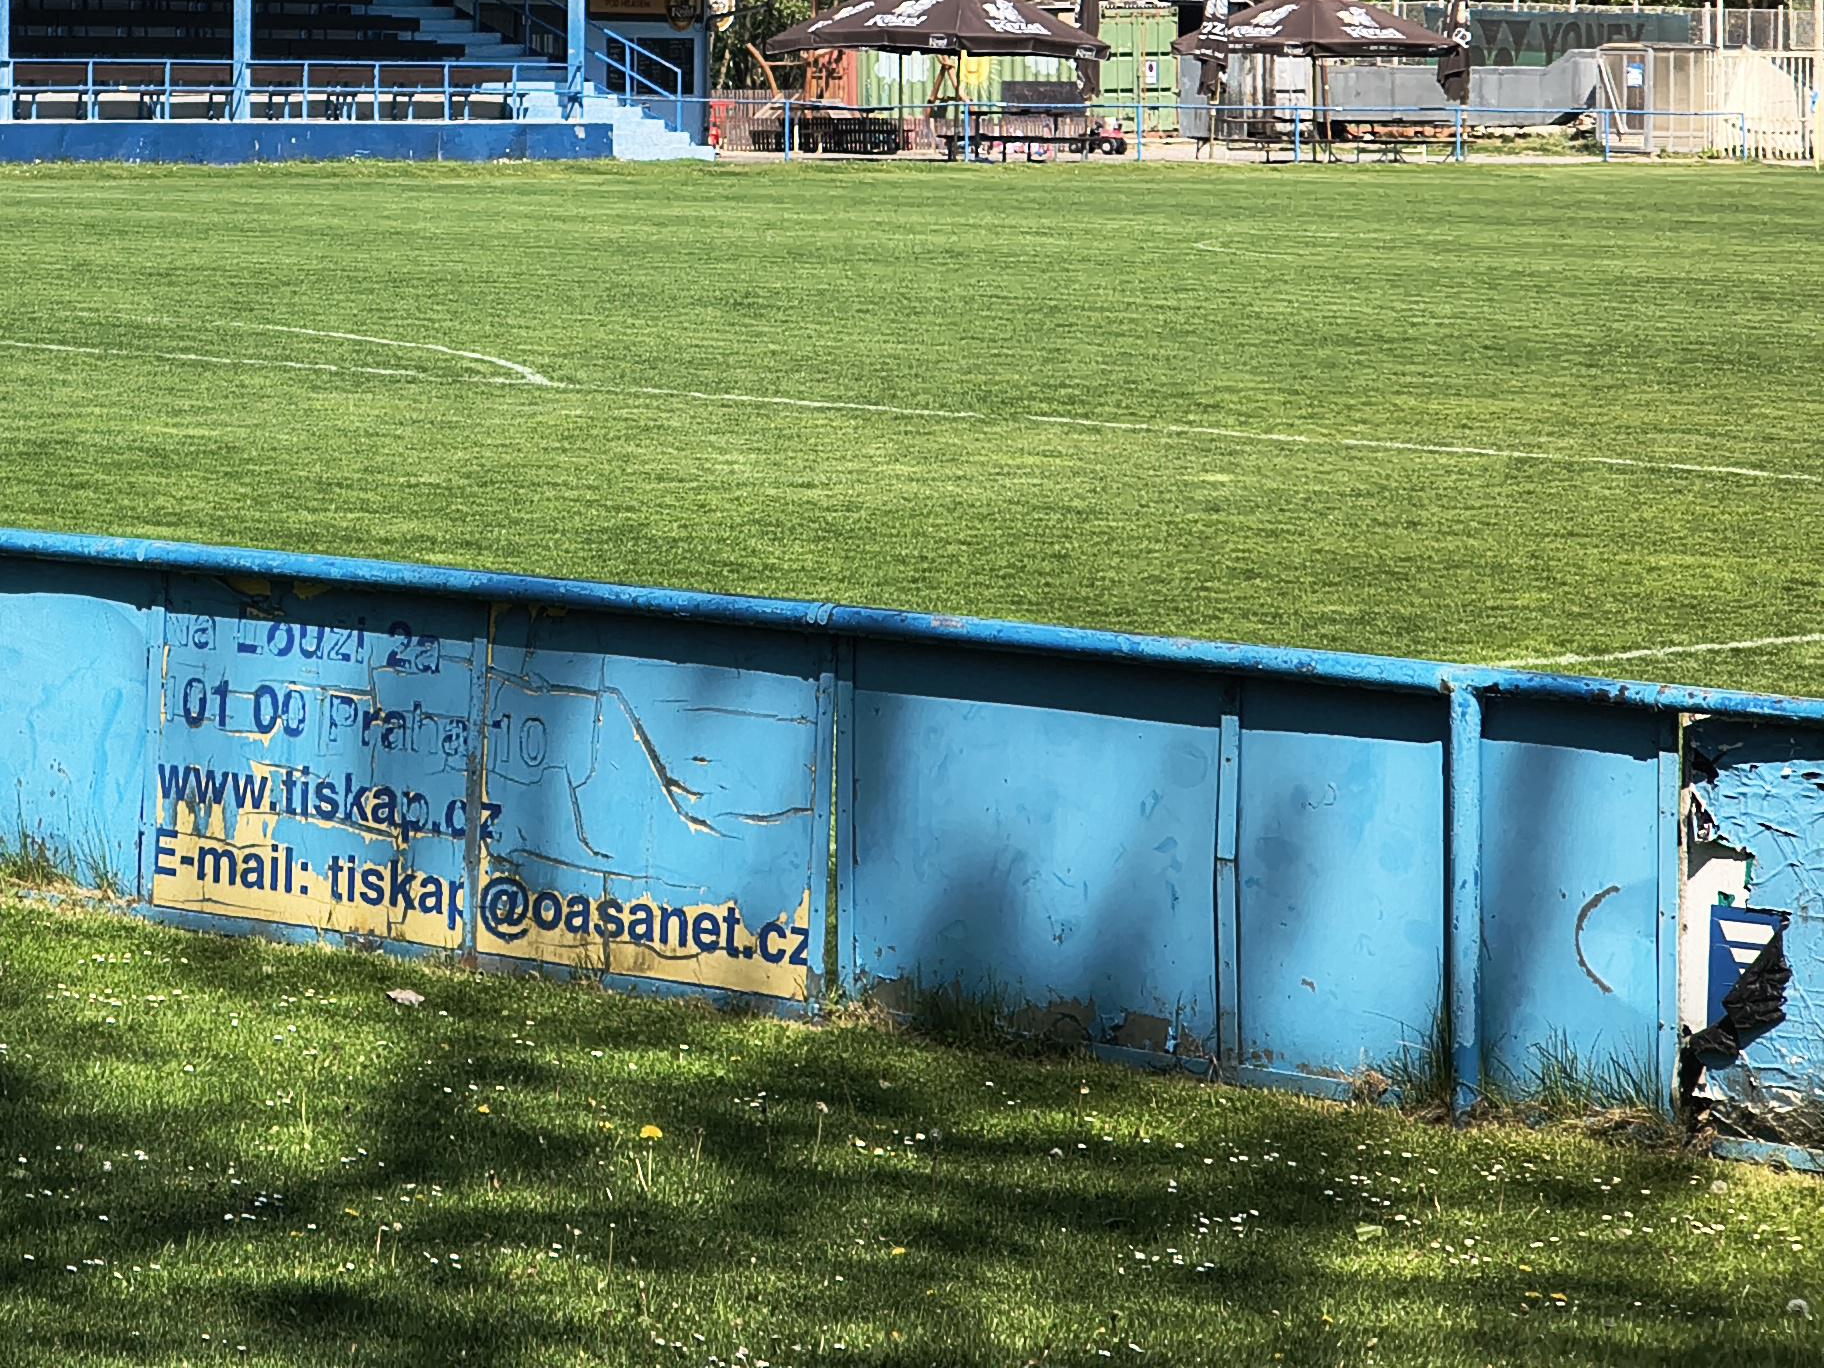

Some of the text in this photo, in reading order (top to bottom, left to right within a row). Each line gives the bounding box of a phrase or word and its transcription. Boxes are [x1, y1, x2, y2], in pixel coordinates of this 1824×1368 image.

[387, 620, 441, 675] 2a
[253, 683, 307, 738] 00
[328, 694, 469, 757] Praha
[157, 763, 504, 842] www.tiskap.cz
[155, 827, 810, 966] E-mail: tiskap@oasanet.cz
